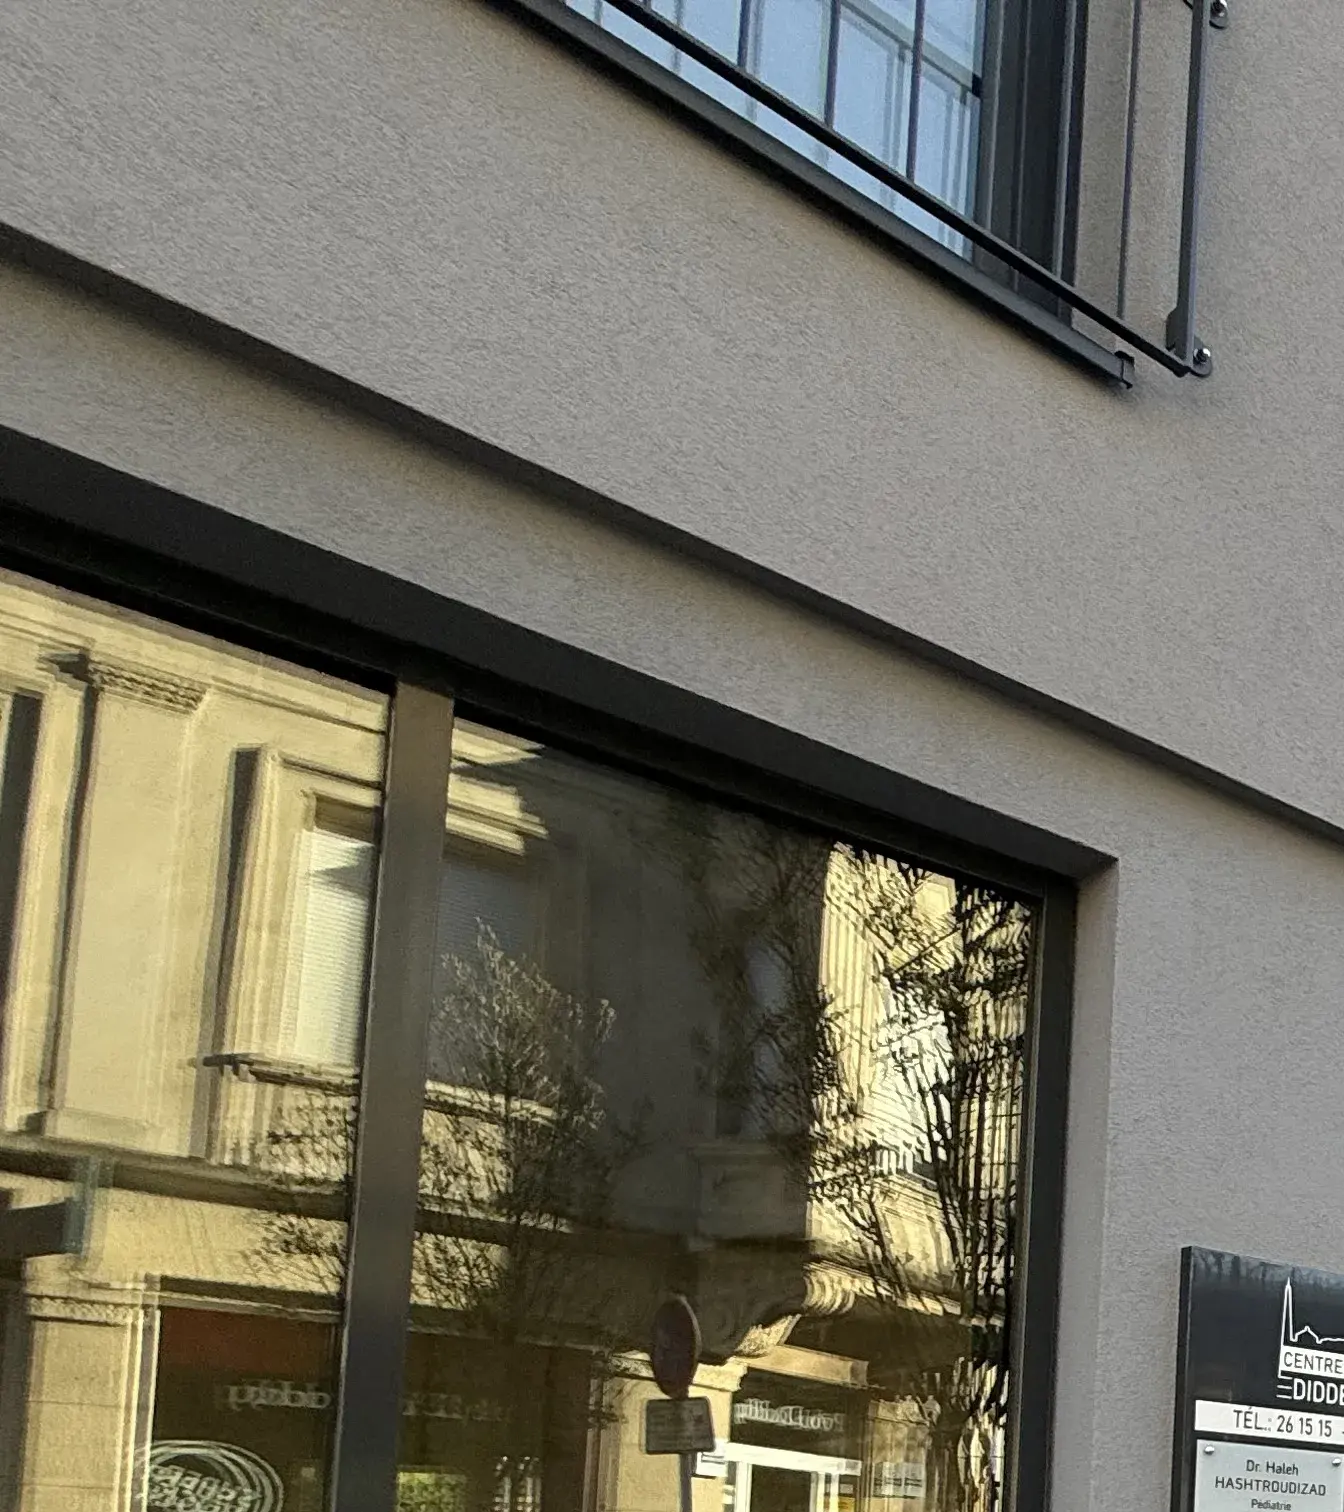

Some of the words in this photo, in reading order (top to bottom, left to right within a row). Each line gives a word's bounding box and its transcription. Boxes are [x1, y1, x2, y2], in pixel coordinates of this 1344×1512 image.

[1283, 1352, 1343, 1375] CENTRE
[1276, 1415, 1294, 1434] 26
[1298, 1418, 1313, 1435] 15
[1318, 1419, 1332, 1437] 15
[1246, 1459, 1261, 1472] Dr.
[1266, 1461, 1299, 1476] Haleh
[1215, 1476, 1326, 1496] HASHTROUDIZAD
